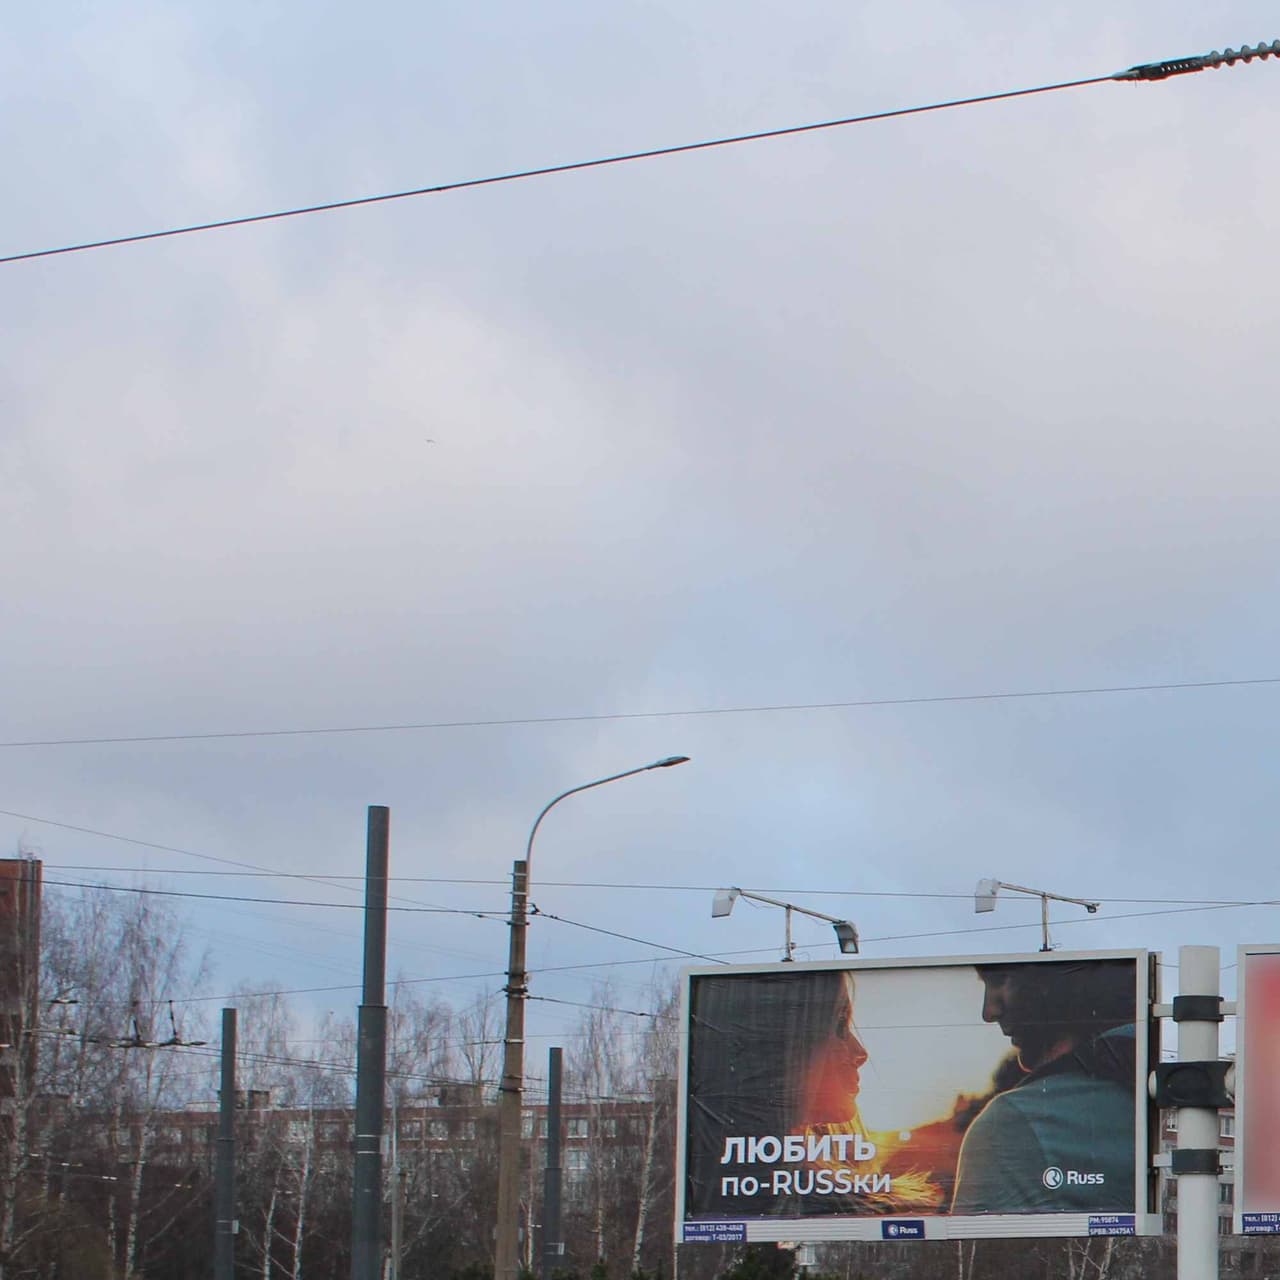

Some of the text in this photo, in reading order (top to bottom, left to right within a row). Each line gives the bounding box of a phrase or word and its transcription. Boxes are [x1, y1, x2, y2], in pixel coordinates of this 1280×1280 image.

[720, 1135, 876, 1164] ЛЮБИТЬ
[721, 1169, 891, 1196] по-RUSSки
[1067, 1170, 1105, 1185] Russ
[899, 1226, 918, 1234] Russ
